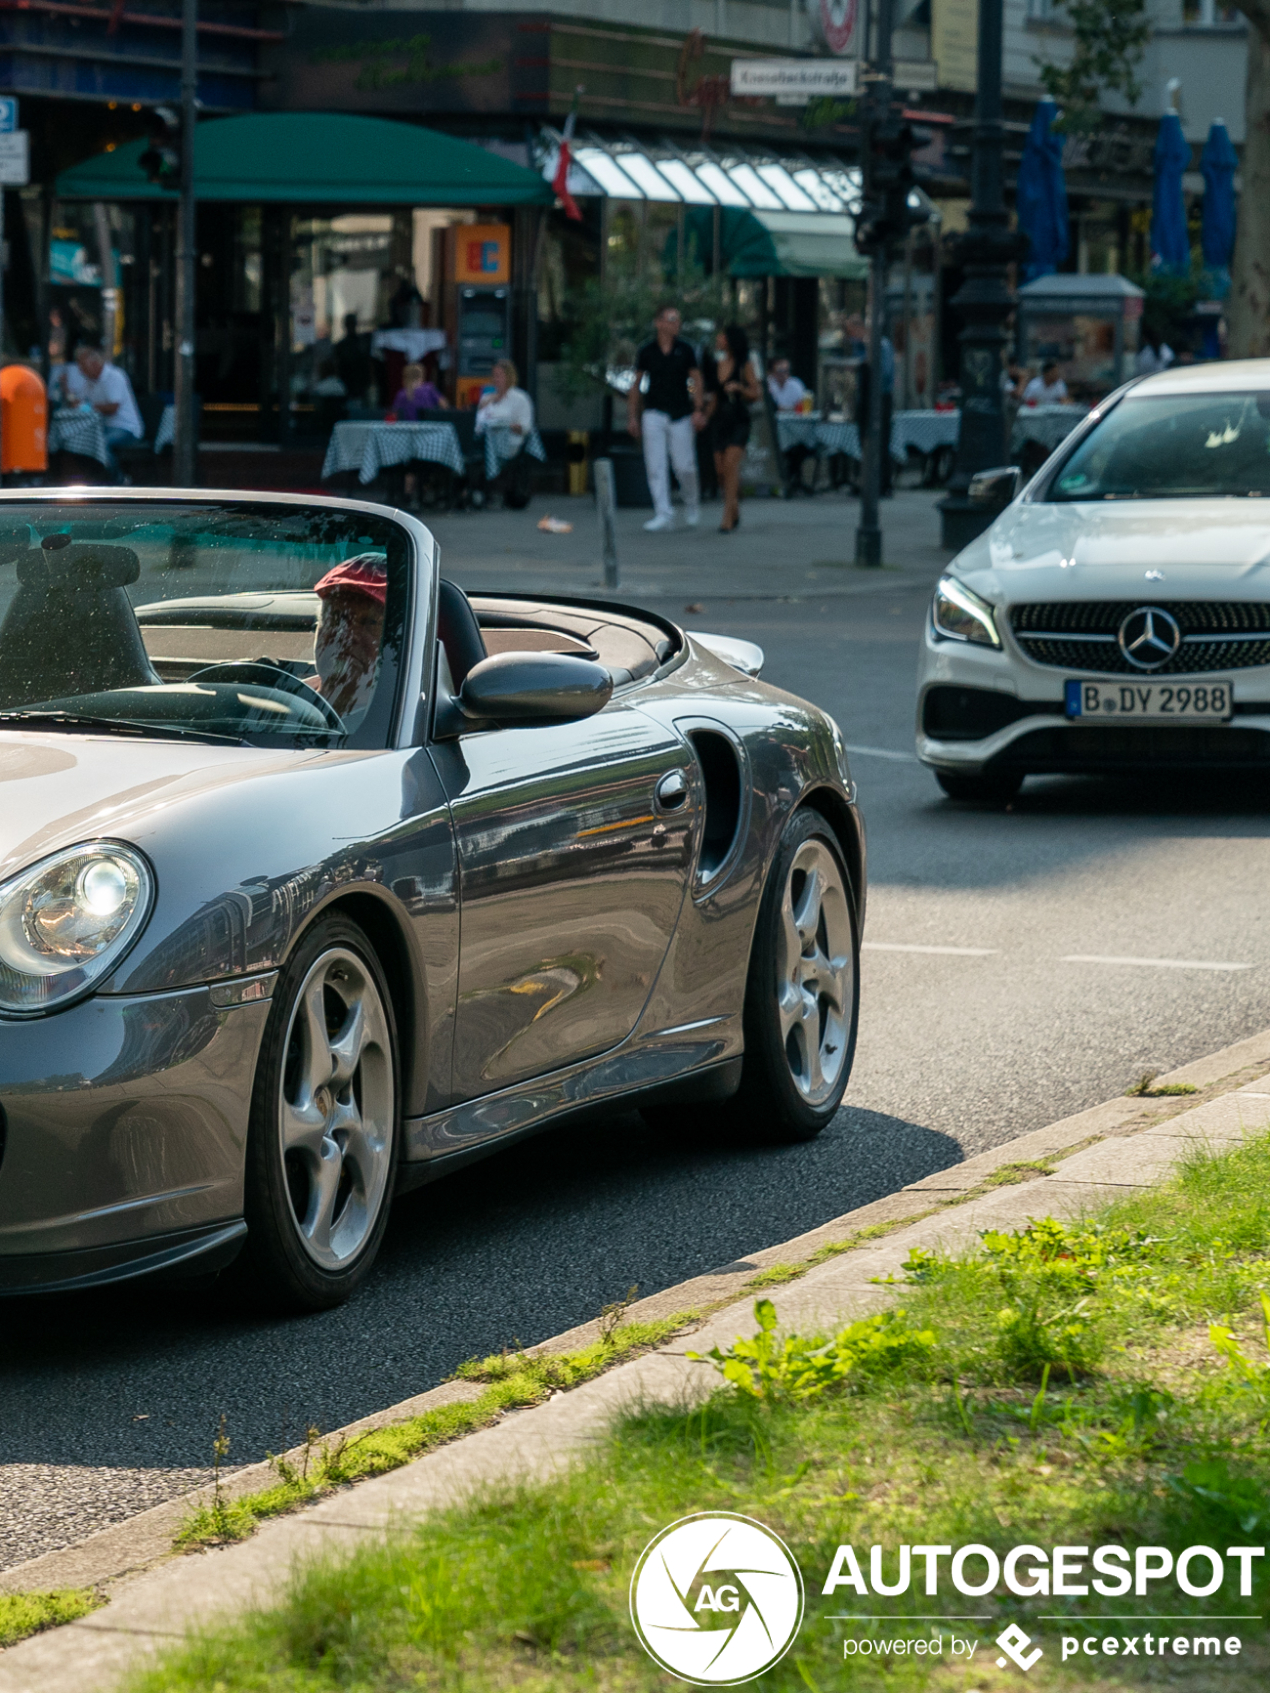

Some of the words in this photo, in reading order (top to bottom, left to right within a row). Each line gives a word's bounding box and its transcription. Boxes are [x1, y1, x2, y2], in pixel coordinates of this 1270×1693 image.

[1084, 686, 1100, 711] B
[1119, 687, 1152, 712] DY
[1159, 688, 1227, 713] 2988
